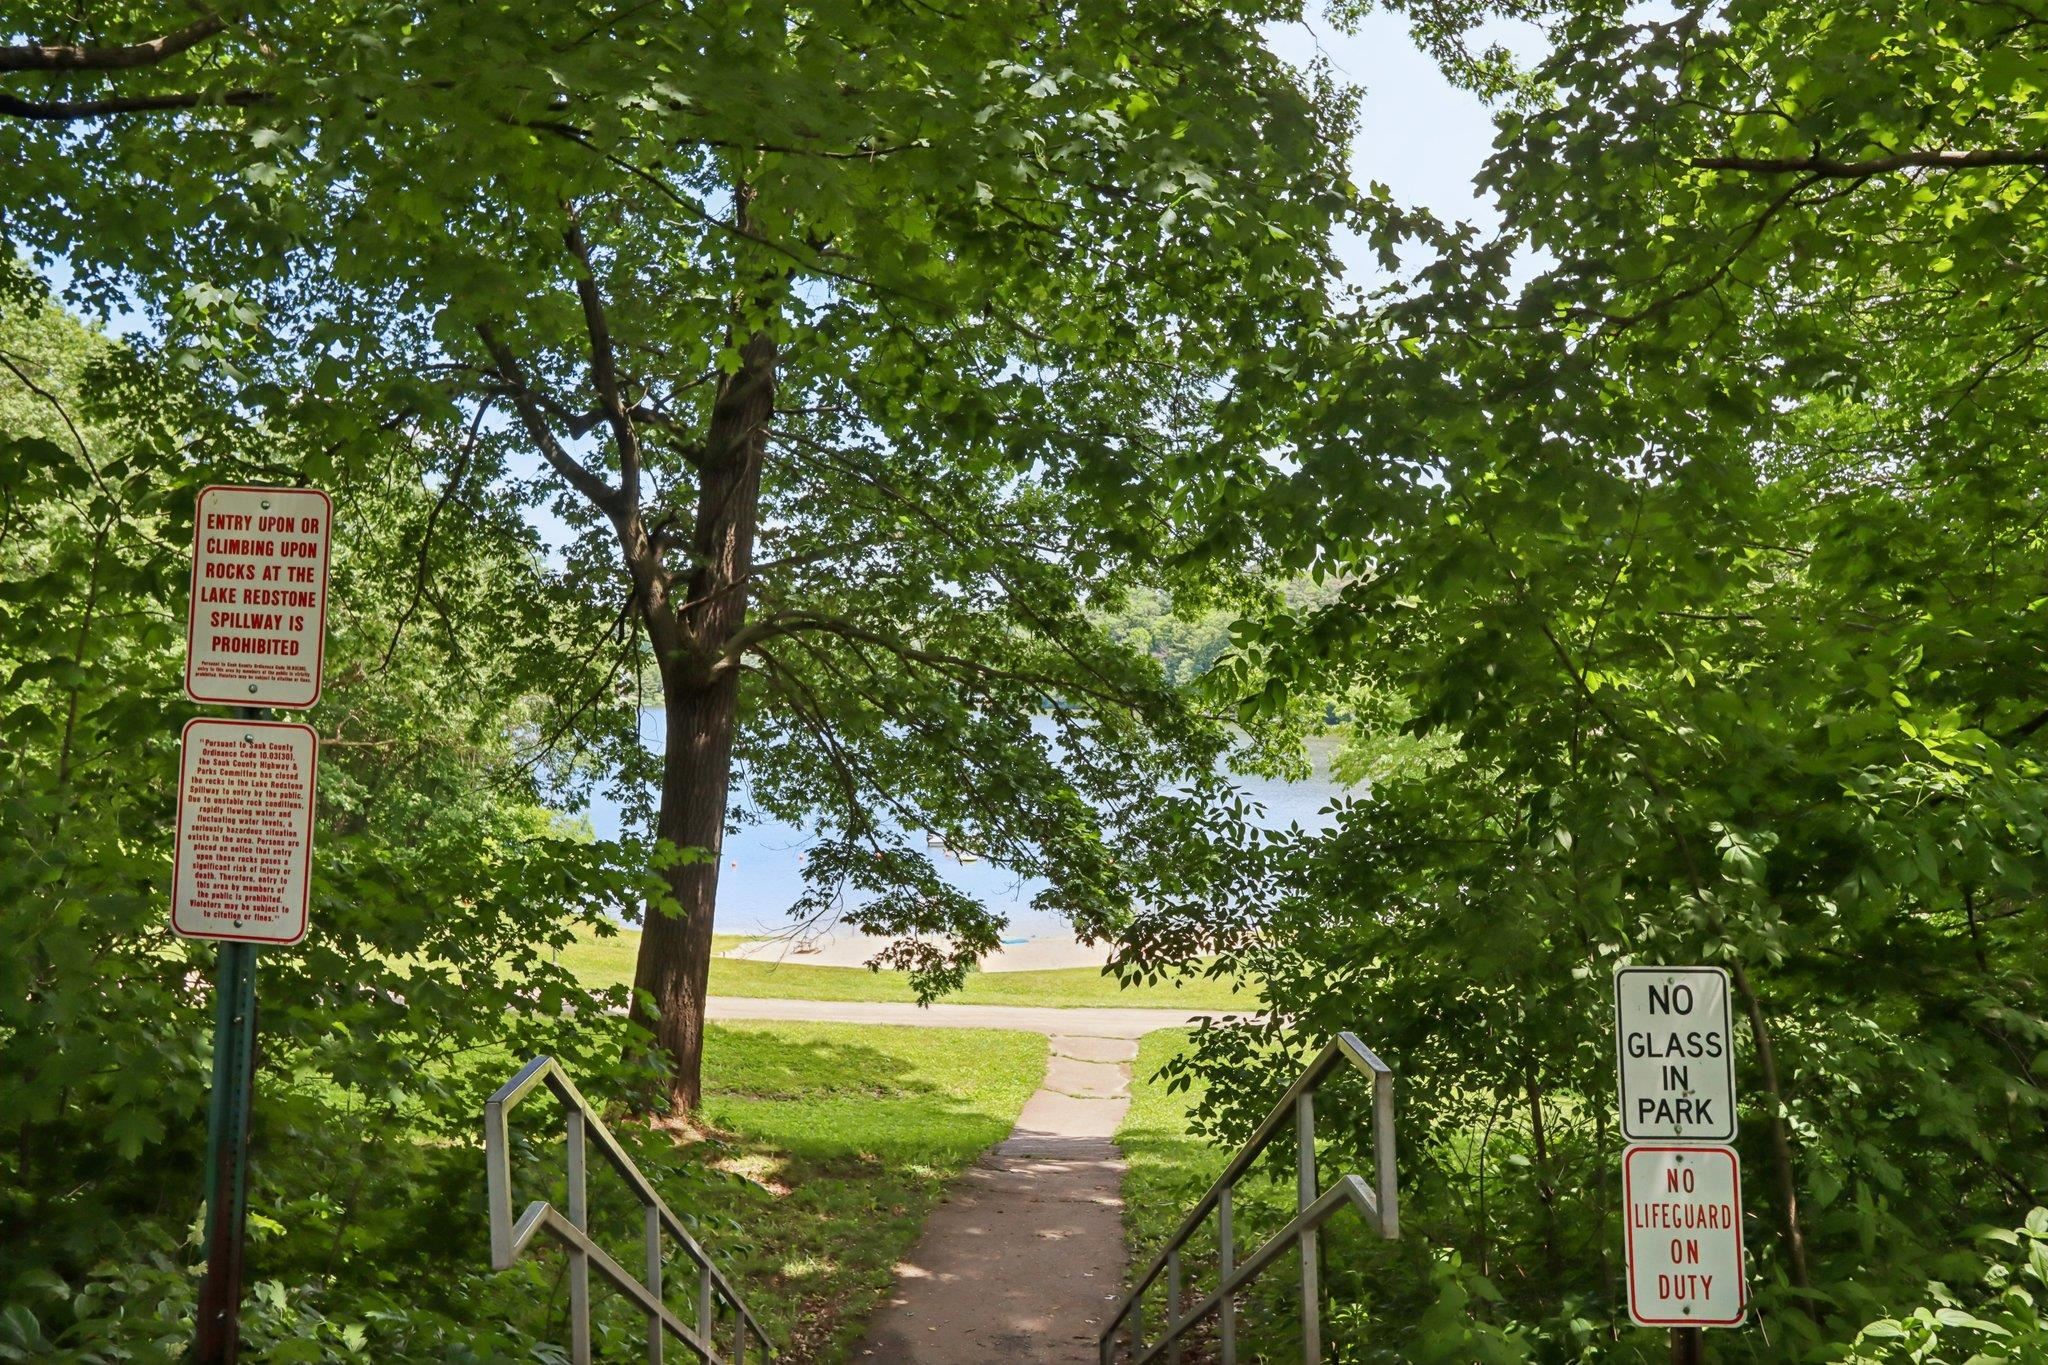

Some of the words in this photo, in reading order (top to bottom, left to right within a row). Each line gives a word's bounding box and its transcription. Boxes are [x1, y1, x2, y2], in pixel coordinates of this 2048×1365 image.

[207, 514, 252, 530] ENTRY
[259, 516, 294, 533] UPON
[302, 518, 319, 534] OR
[207, 538, 274, 556] CLIMBING
[281, 542, 316, 558] UPON
[206, 563, 255, 580] ROCKS
[263, 566, 281, 581] AT
[288, 567, 314, 582] THE
[201, 587, 236, 603] LAKE
[244, 589, 316, 607] REDSTONE
[211, 612, 282, 630] SPILLWAY
[289, 616, 304, 631] IS
[212, 636, 299, 656] PROHIBITED
[202, 748, 237, 757] Ordinance
[269, 743, 293, 751] County
[220, 768, 257, 777] Committee
[233, 760, 256, 768] County
[260, 761, 289, 770] Highway
[190, 786, 219, 795] Spillway
[233, 789, 251, 797] entry
[255, 790, 262, 798] by
[271, 781, 303, 790] Redstone
[227, 807, 252, 816] flowing
[198, 815, 236, 825] fluctuating
[192, 825, 223, 833] seriously
[227, 826, 262, 835] hazardous
[273, 847, 292, 857] entry
[260, 866, 280, 874] injury
[258, 876, 277, 884] entry
[212, 892, 232, 900] public
[253, 904, 278, 912] subject
[1648, 985, 1693, 1015] NO
[1628, 1032, 1722, 1058] GLASS
[1663, 1066, 1688, 1090] IN
[1638, 1098, 1713, 1124] PARK
[1667, 1169, 1694, 1193] NO
[1635, 1204, 1731, 1229] LIFEGUARD
[1671, 1239, 1698, 1264] ON
[1659, 1275, 1713, 1300] DUTY
